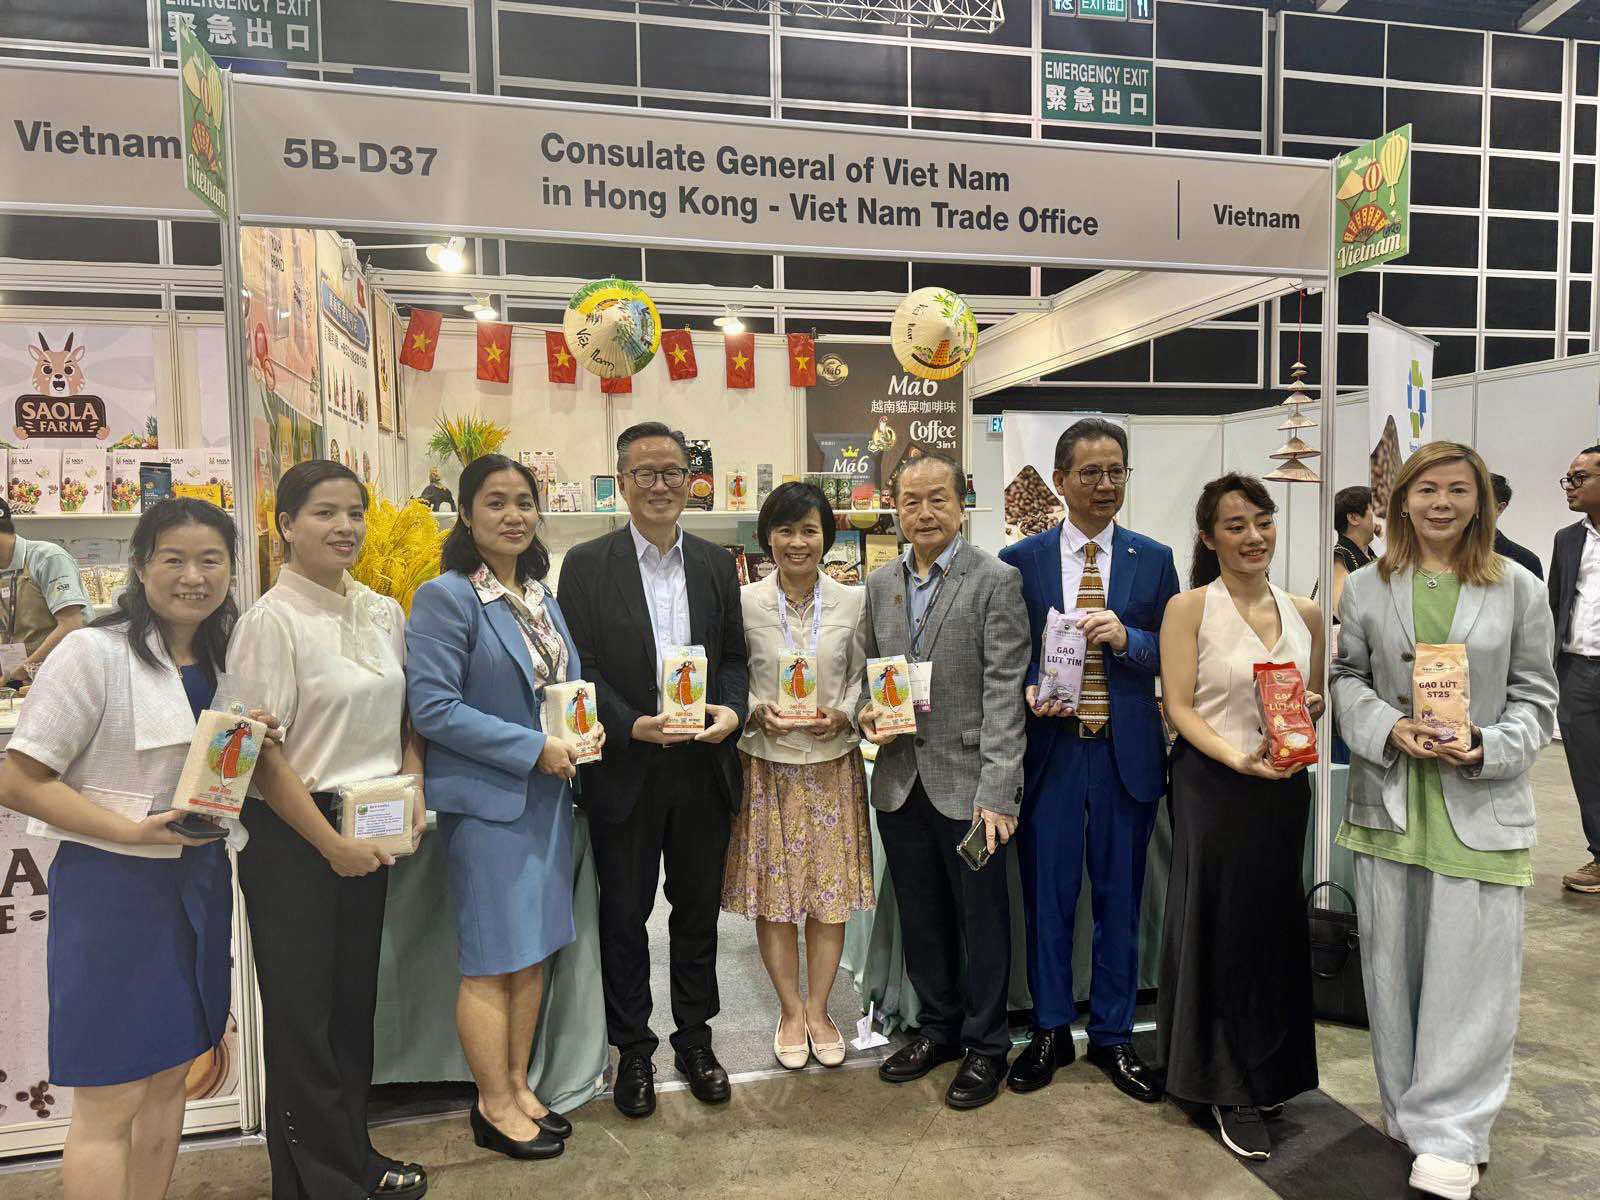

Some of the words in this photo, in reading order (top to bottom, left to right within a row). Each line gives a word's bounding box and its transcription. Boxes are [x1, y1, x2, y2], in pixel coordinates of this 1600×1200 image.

[1045, 61, 1120, 84] EMERGENCY
[1123, 67, 1149, 86] EXIT
[1046, 84, 1147, 116] 緊急出口
[14, 119, 182, 159] Vietnam
[283, 137, 438, 177] 5B-D37
[541, 132, 705, 172] Consulate
[716, 145, 835, 181] General
[846, 156, 875, 183] of
[882, 157, 938, 188] Viet
[949, 163, 1010, 191] Nam
[188, 154, 228, 213] Vietnam
[542, 176, 571, 206] in
[584, 179, 666, 218] Hong
[679, 185, 758, 224] Kong
[789, 192, 847, 223] Viet
[857, 197, 921, 226] Nam
[931, 201, 1009, 231] Trade
[1019, 206, 1098, 236] Office
[1213, 203, 1300, 230] Vietnam
[1338, 233, 1400, 269] Vietnam
[22, 402, 99, 420] SAOLA
[40, 422, 83, 433] FARM
[909, 420, 956, 443] Coffee
[936, 441, 956, 449] 3in1
